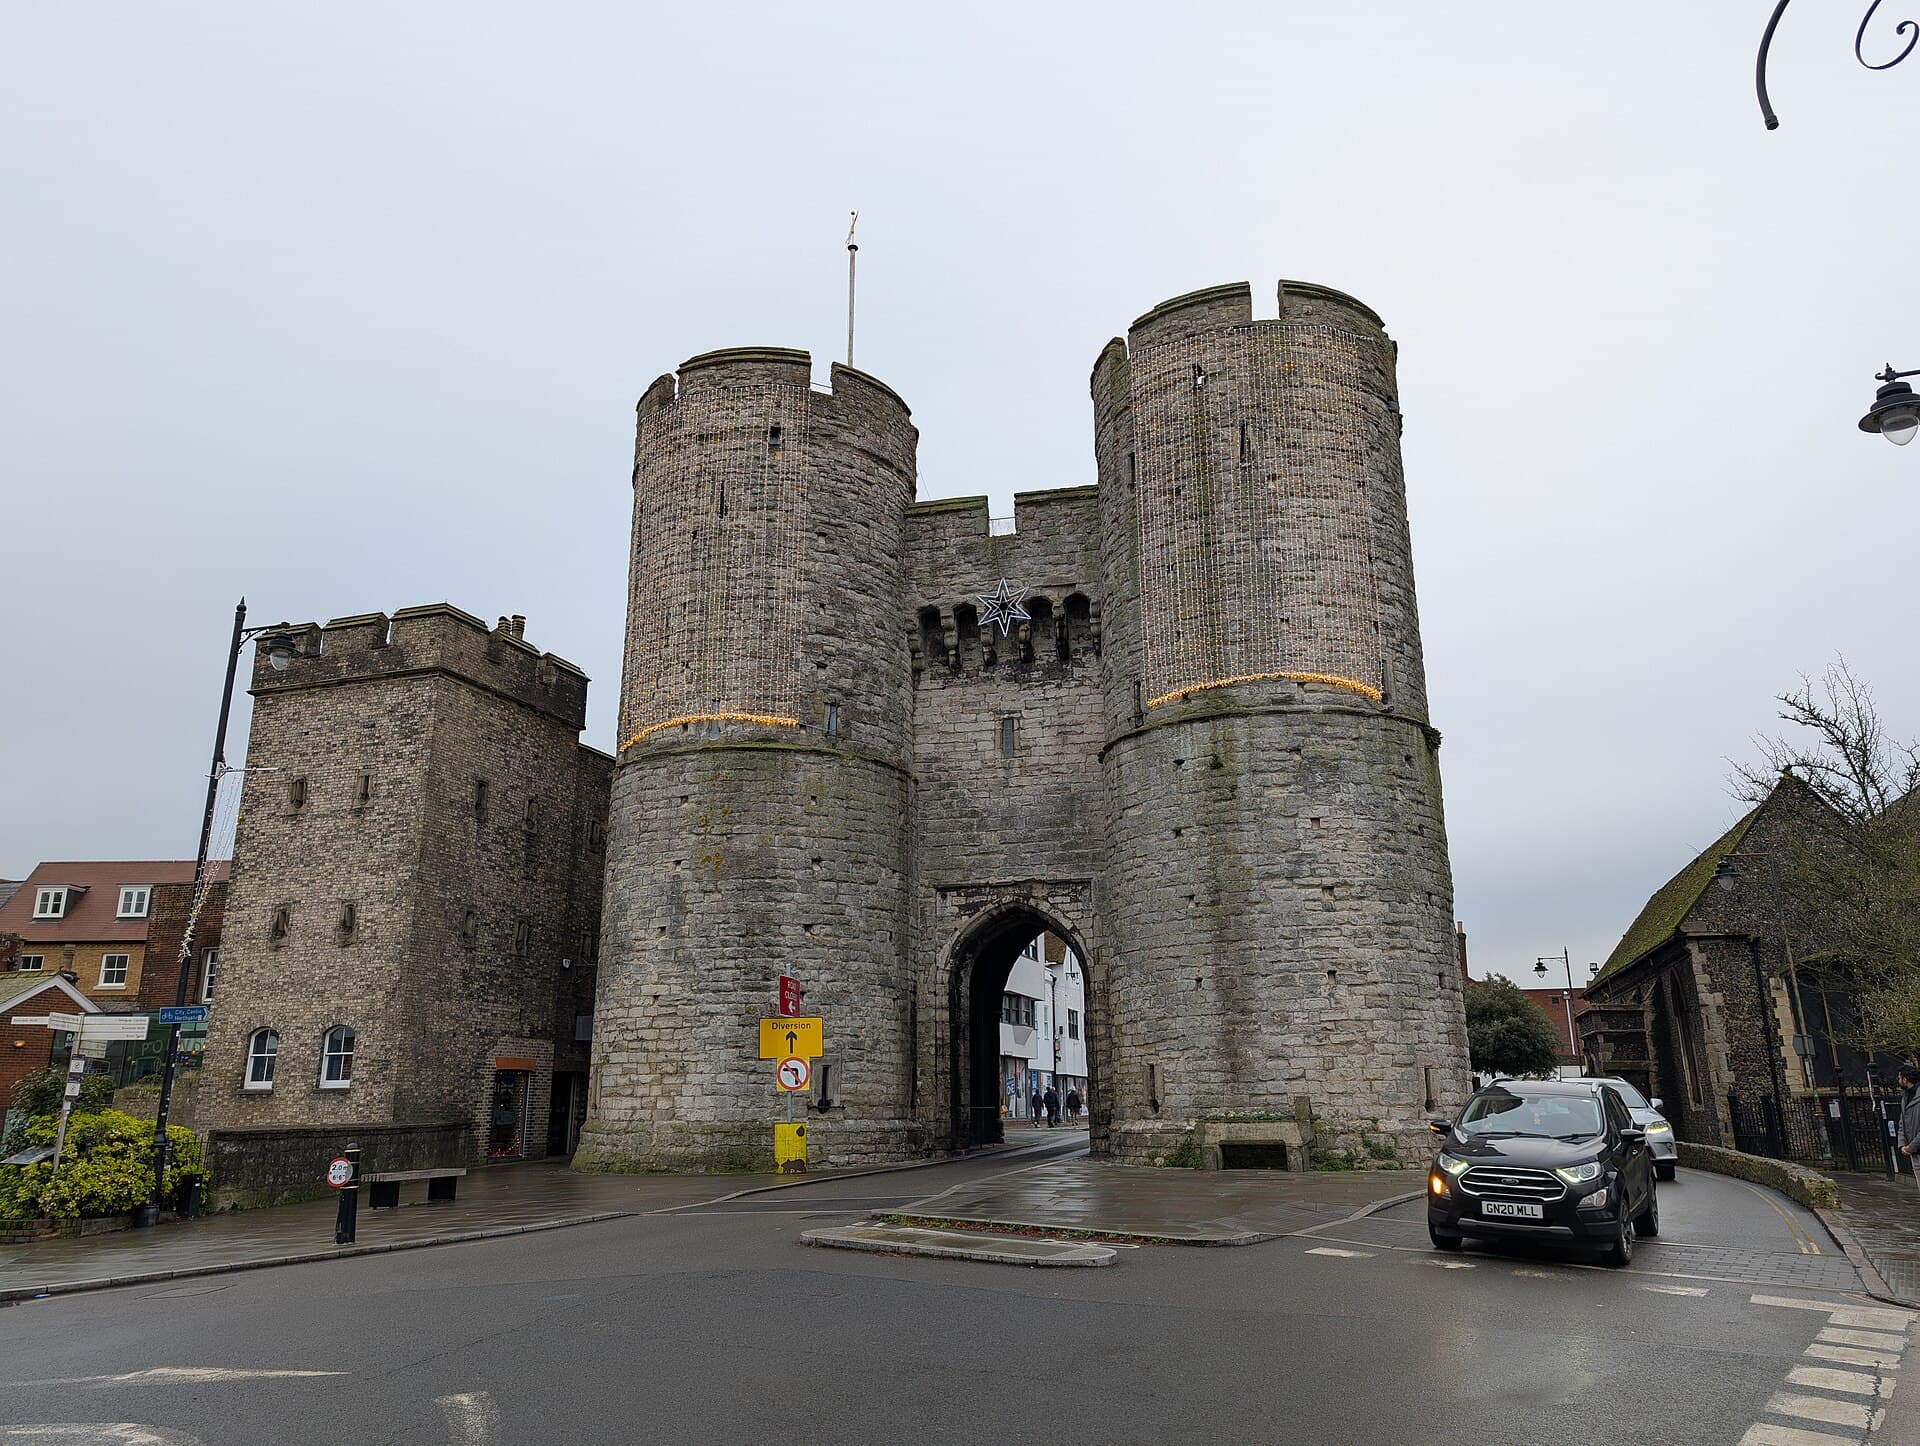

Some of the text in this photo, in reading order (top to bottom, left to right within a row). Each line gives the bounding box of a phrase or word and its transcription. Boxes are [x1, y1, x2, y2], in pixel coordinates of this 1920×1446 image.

[771, 1022, 811, 1030] Diversion
[1486, 1203, 1538, 1217] GN20 MLL
